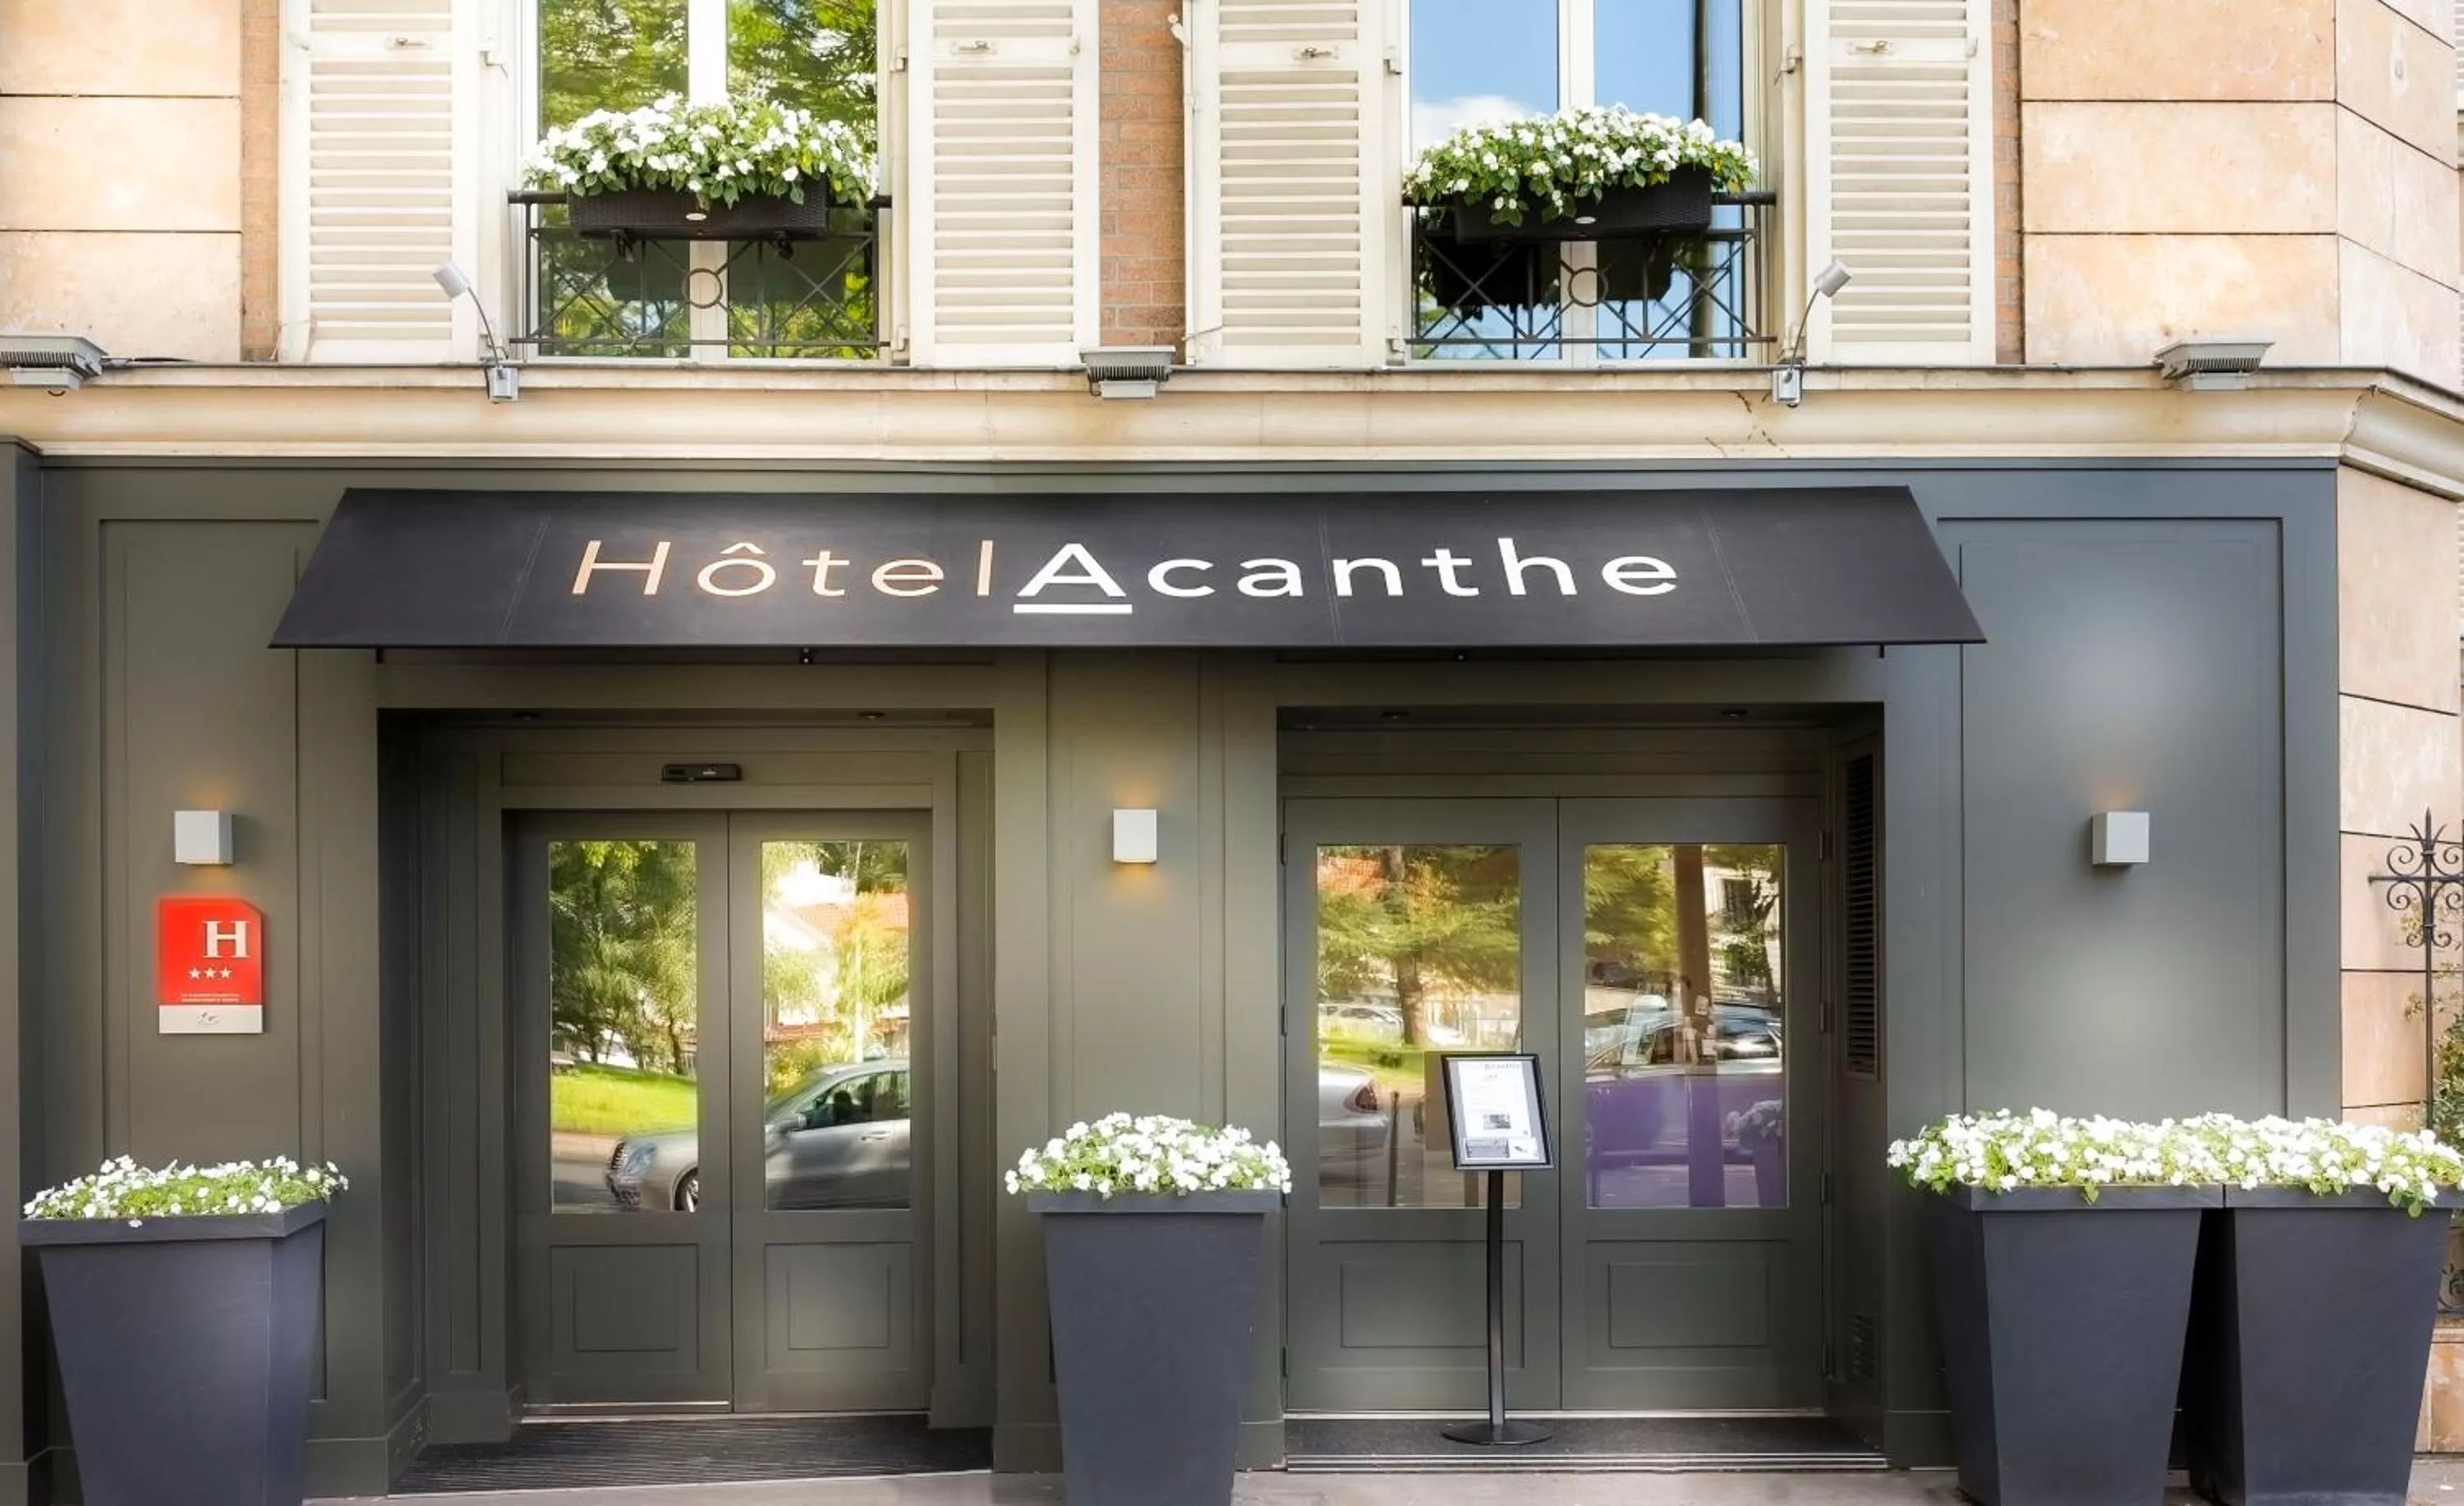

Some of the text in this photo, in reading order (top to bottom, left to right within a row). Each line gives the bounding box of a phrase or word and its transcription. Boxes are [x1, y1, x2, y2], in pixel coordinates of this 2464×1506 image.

[572, 537, 1680, 604] Hôtel Acanthe
[202, 921, 250, 958] H
